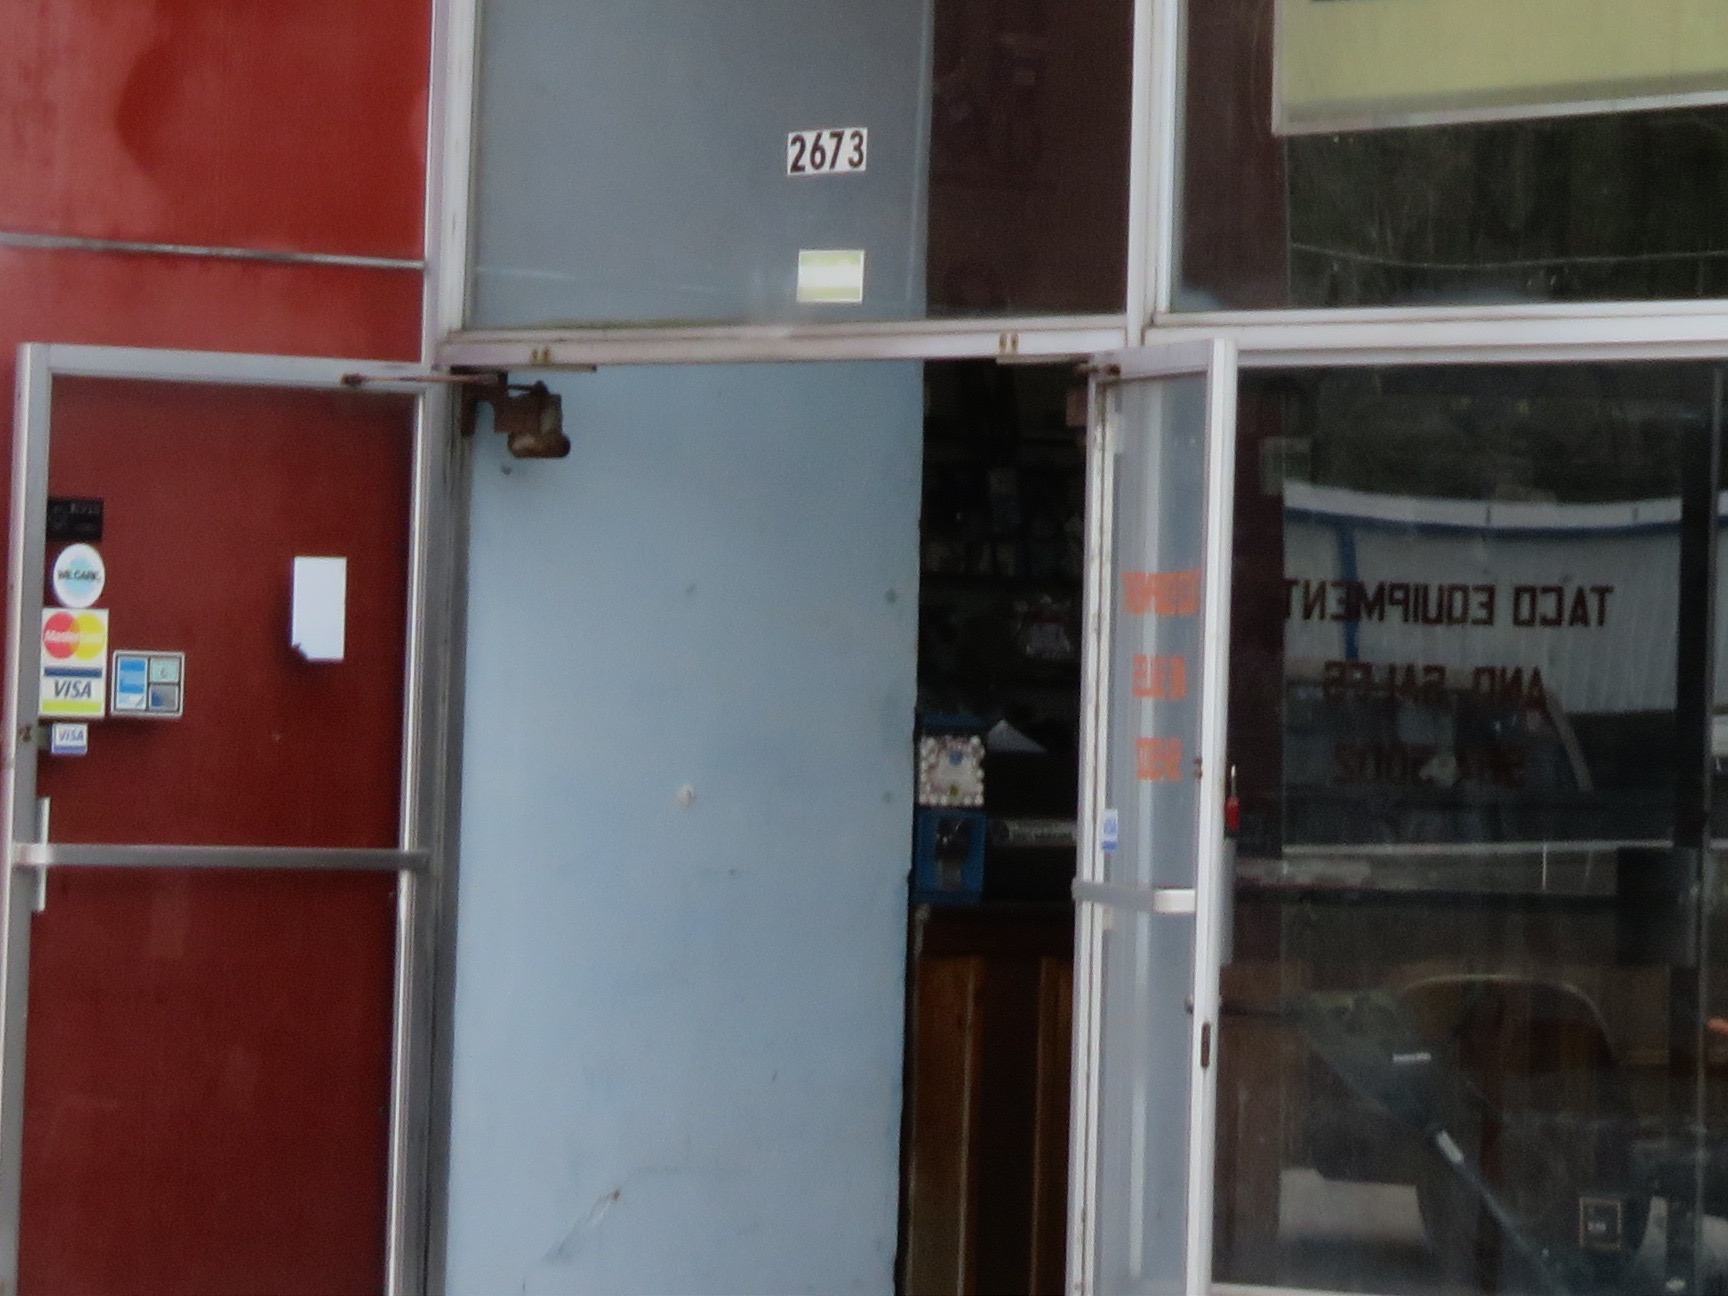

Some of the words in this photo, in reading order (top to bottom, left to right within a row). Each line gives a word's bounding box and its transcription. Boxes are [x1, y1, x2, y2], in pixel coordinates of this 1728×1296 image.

[789, 129, 865, 174] 2673
[54, 679, 92, 699] VISA
[58, 728, 85, 743] VISA
